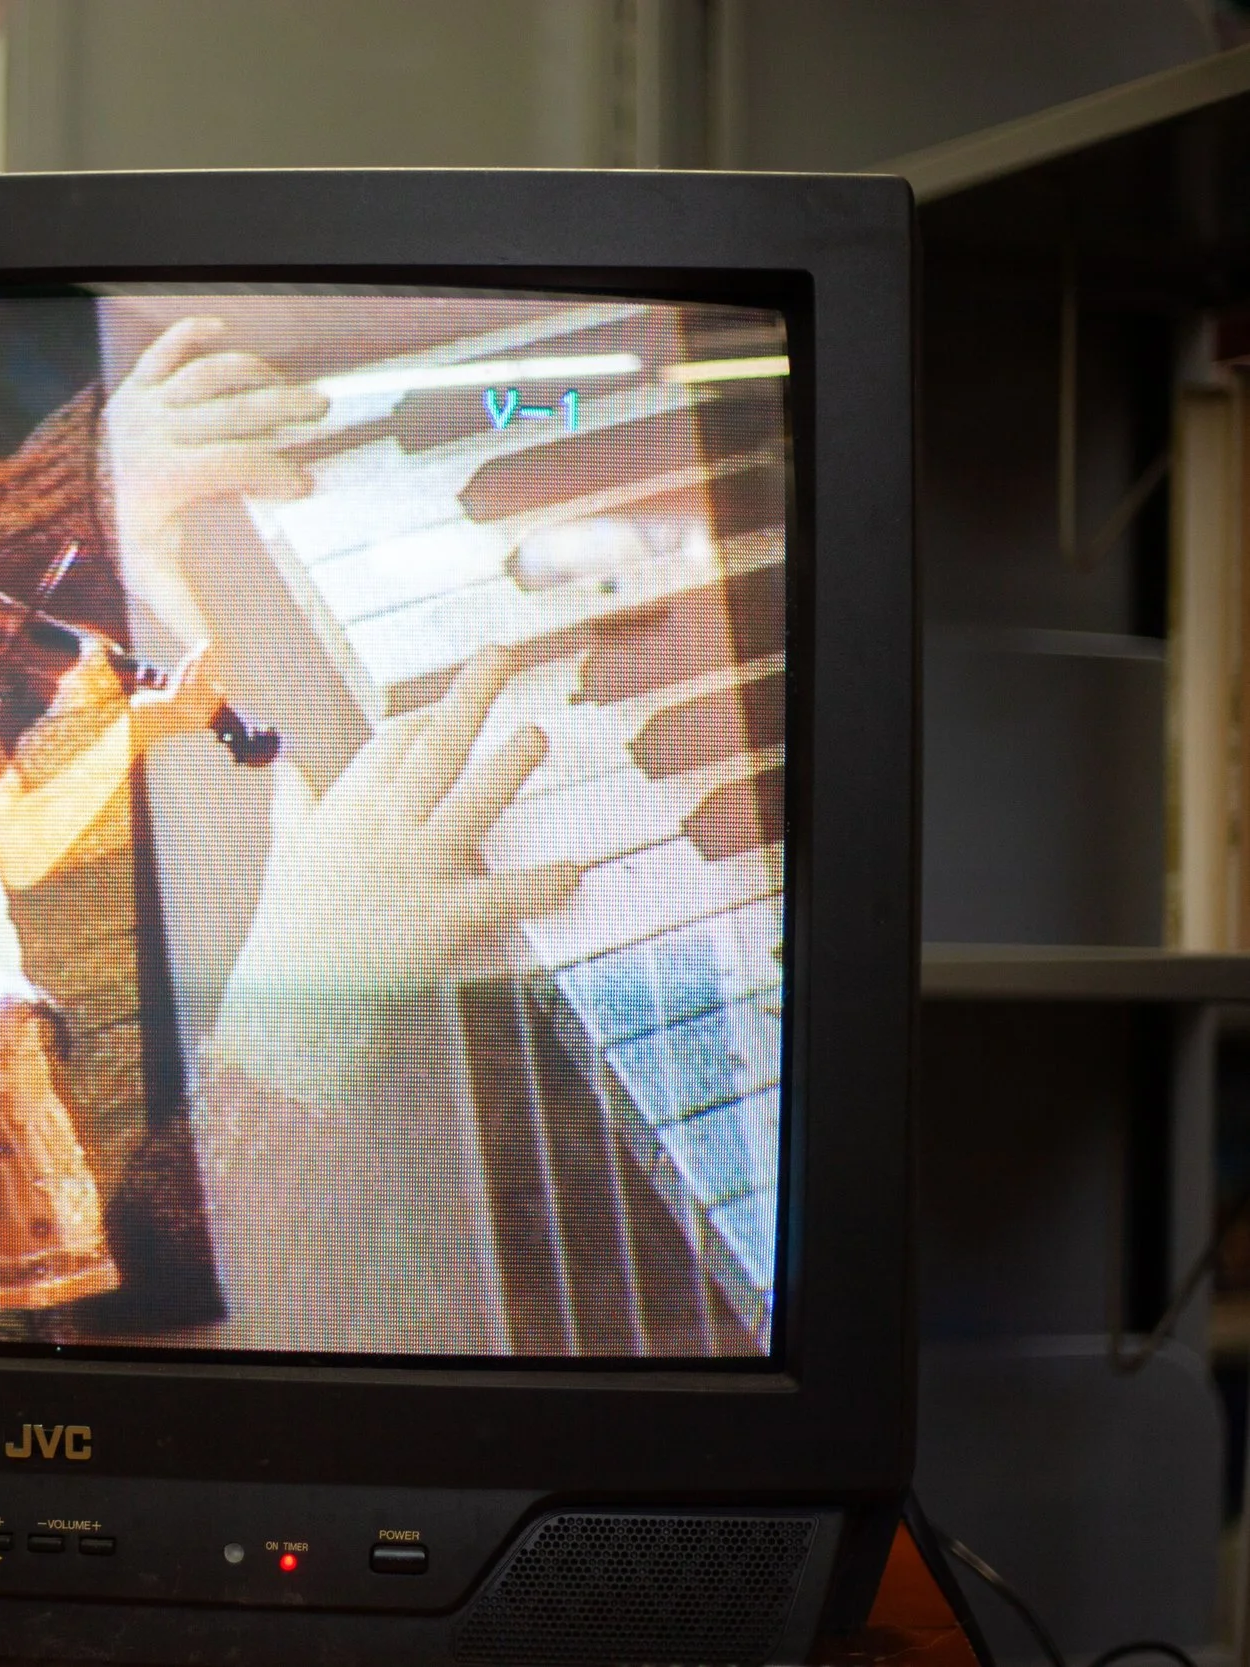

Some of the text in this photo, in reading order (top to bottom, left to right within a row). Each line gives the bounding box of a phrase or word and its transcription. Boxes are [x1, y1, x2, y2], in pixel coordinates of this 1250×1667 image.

[483, 388, 579, 432] V-1
[5, 1424, 92, 1460] JVC
[265, 1541, 309, 1552] ON TIMER
[378, 1529, 421, 1542] POWER
